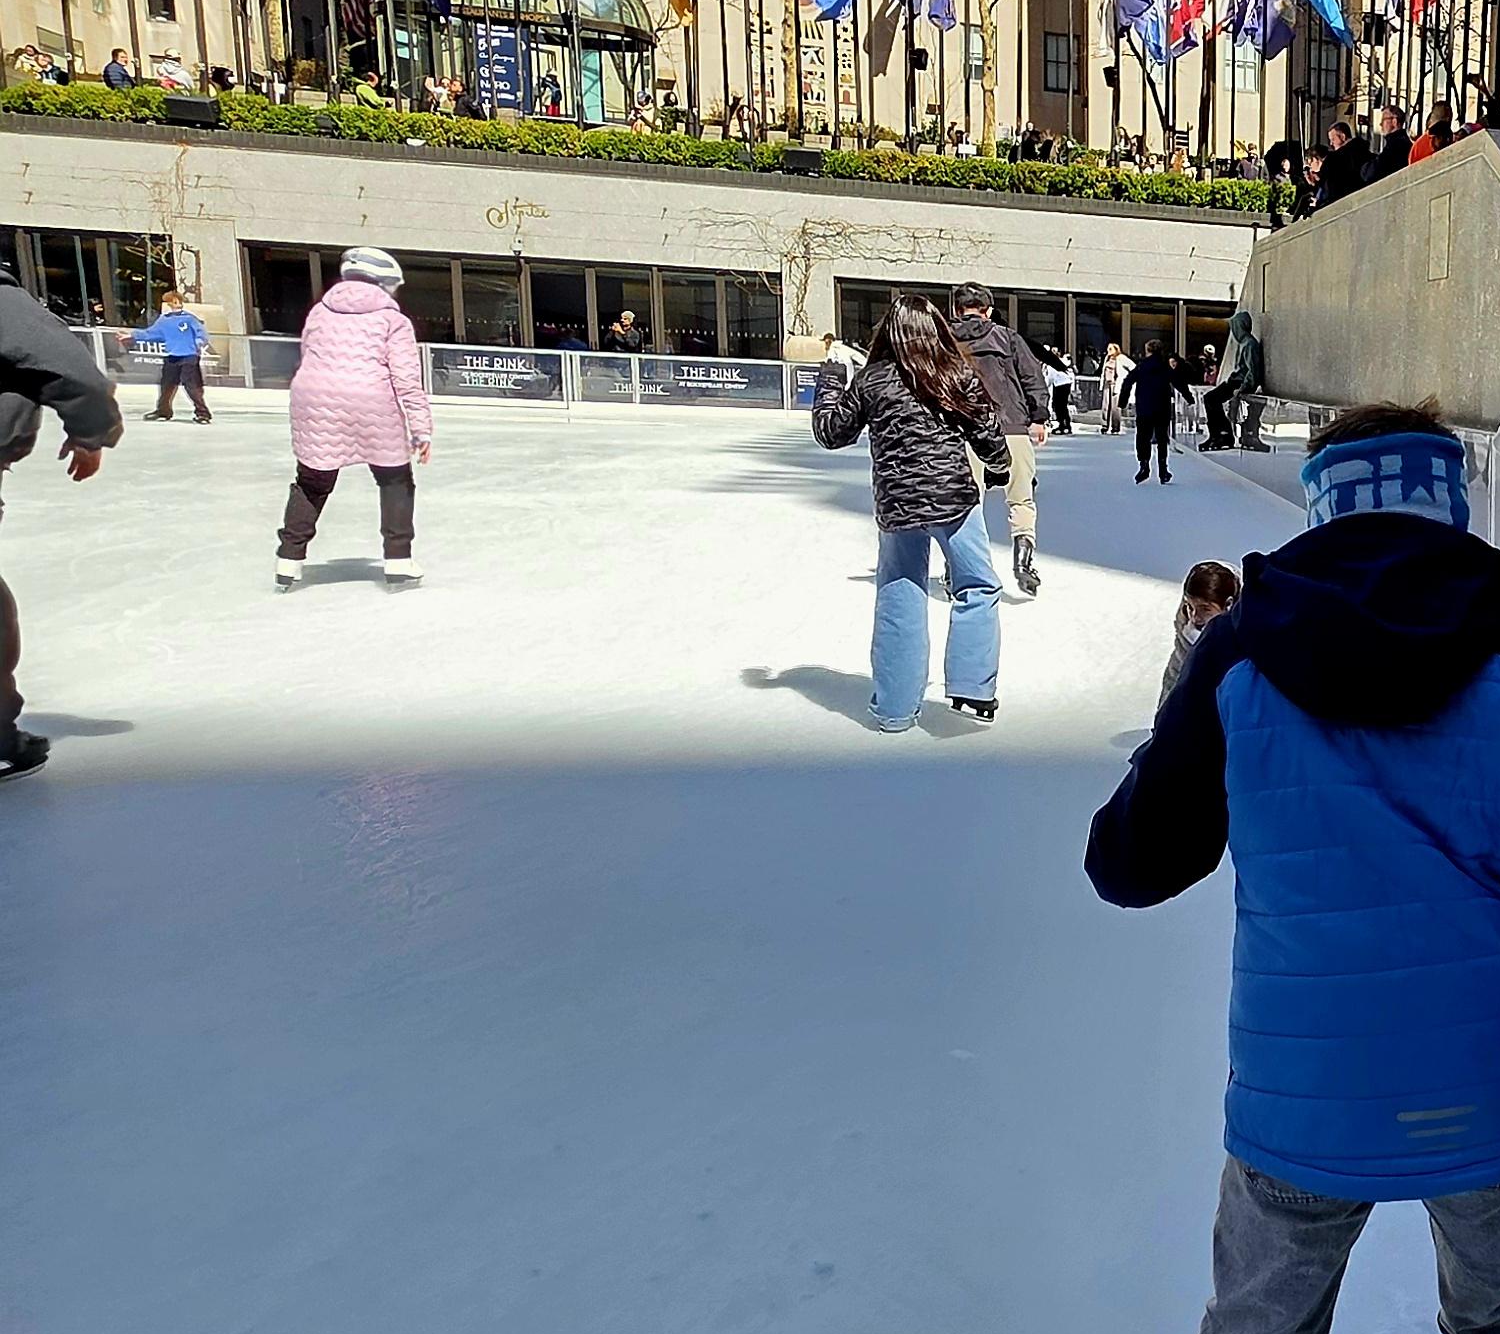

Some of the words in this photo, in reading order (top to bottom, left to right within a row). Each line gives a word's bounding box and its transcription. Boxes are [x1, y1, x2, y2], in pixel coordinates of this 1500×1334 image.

[136, 341, 167, 354] THE
[463, 355, 490, 368] THE
[493, 357, 526, 370] RINK
[681, 366, 706, 378] THE
[710, 367, 741, 380] RINK
